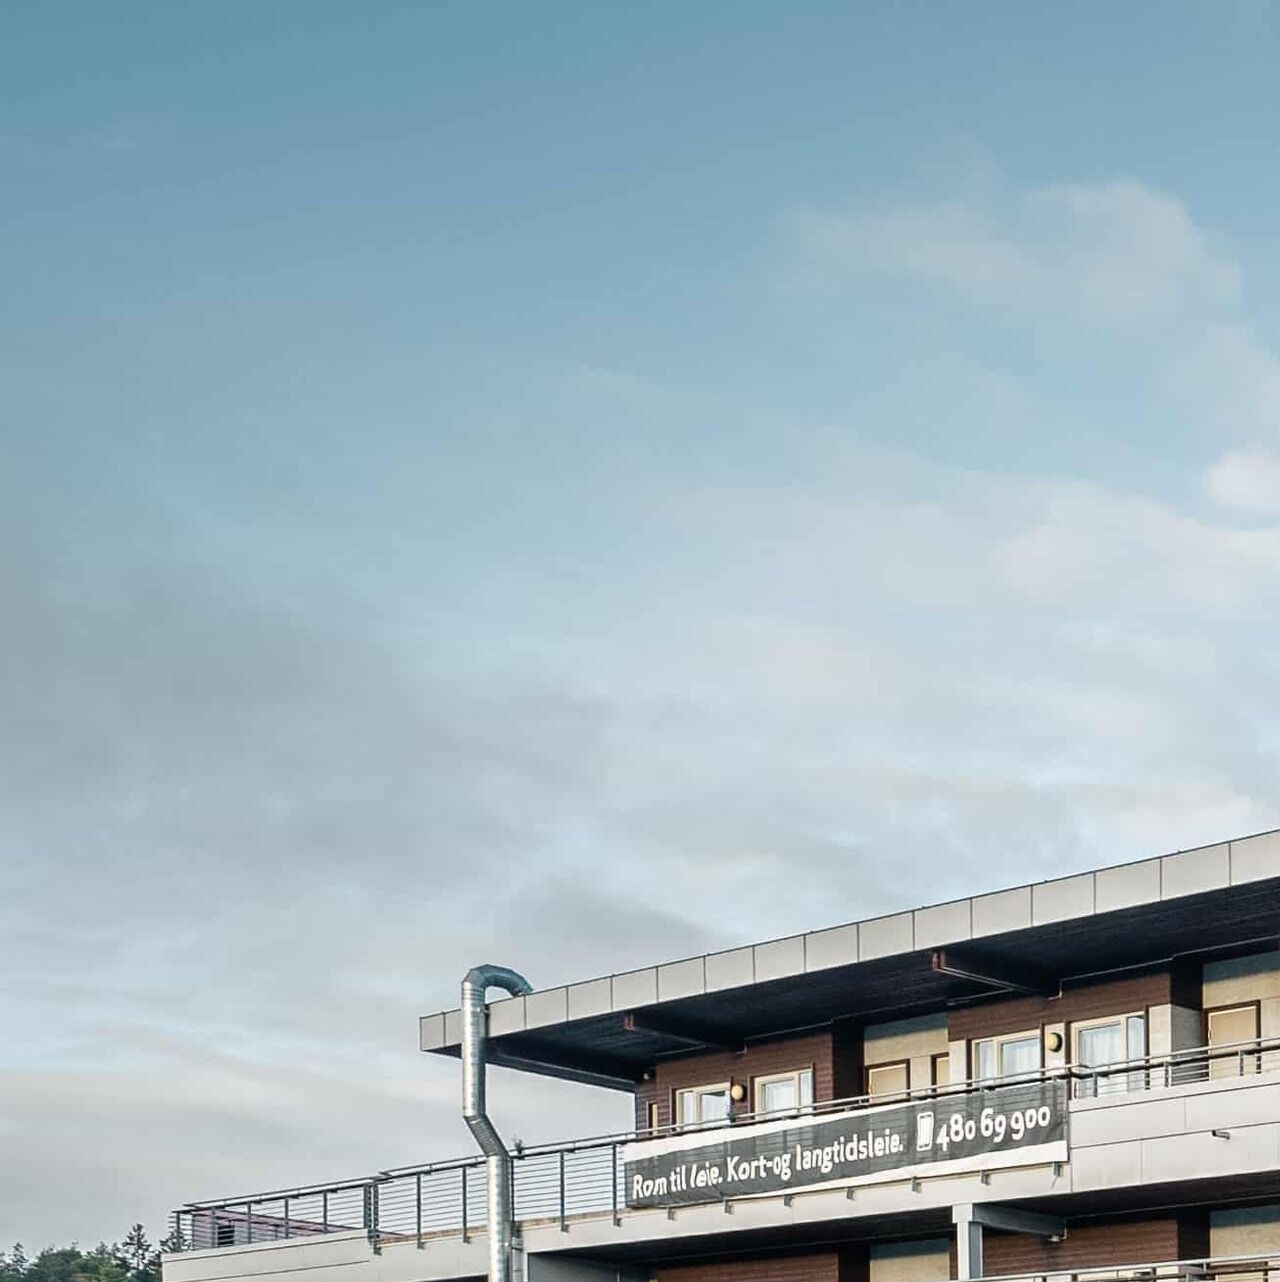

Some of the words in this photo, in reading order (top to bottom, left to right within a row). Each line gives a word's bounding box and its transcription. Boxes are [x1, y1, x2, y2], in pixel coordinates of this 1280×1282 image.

[632, 1174, 668, 1200] Rom
[670, 1165, 687, 1190] til
[690, 1163, 724, 1189] leie.
[727, 1155, 791, 1182] Kort-og
[796, 1128, 904, 1174] langtidsleie.
[936, 1113, 976, 1152] 480
[980, 1107, 1006, 1143] 69
[1010, 1105, 1051, 1141] 900
